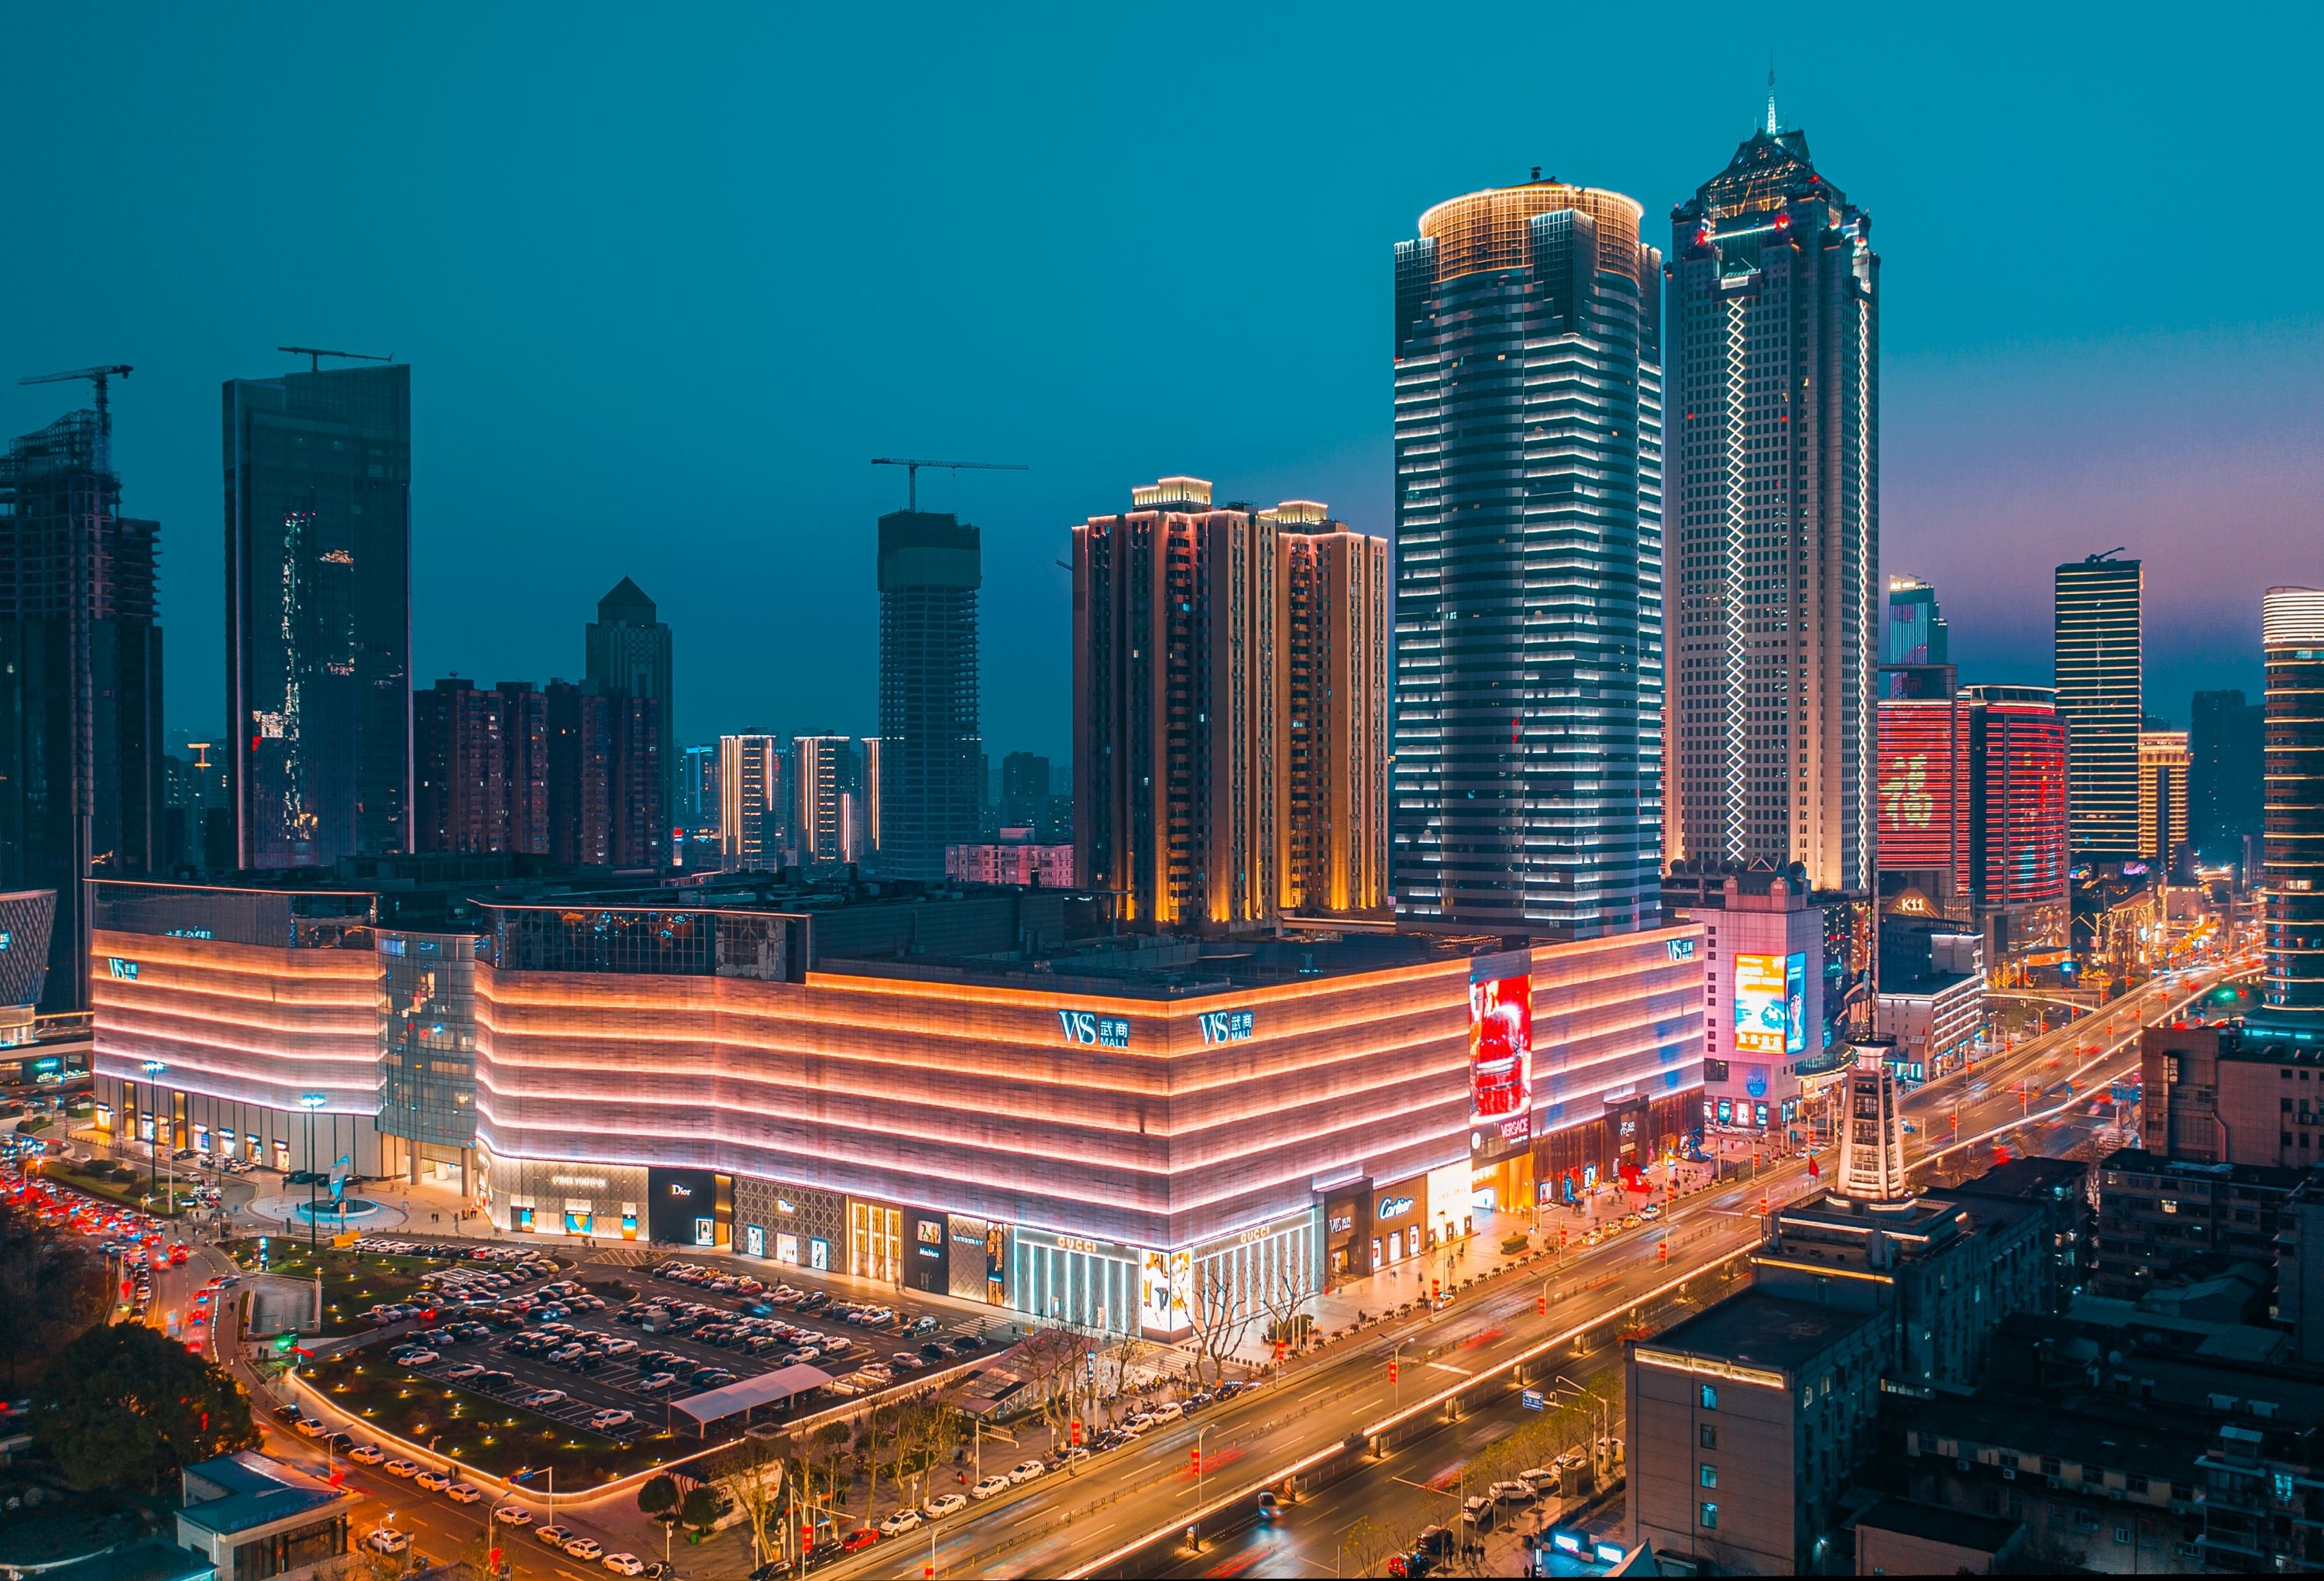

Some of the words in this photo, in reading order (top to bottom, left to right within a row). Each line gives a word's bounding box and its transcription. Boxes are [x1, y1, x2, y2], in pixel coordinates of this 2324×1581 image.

[1879, 748, 1934, 831] 福
[1902, 898, 1924, 911] K11
[1100, 1021, 1129, 1039] 武商
[1231, 1014, 1253, 1031] 武商
[1100, 1037, 1129, 1049] MALL
[1231, 1029, 1253, 1042] MALL
[1501, 1117, 1528, 1139] VERSACE
[672, 1184, 692, 1196] Dior
[1380, 1198, 1413, 1219] Cartier
[953, 1235, 984, 1246] BURBERRY
[1240, 1225, 1270, 1244] GUCCI
[1057, 1236, 1097, 1253] GUCCI
